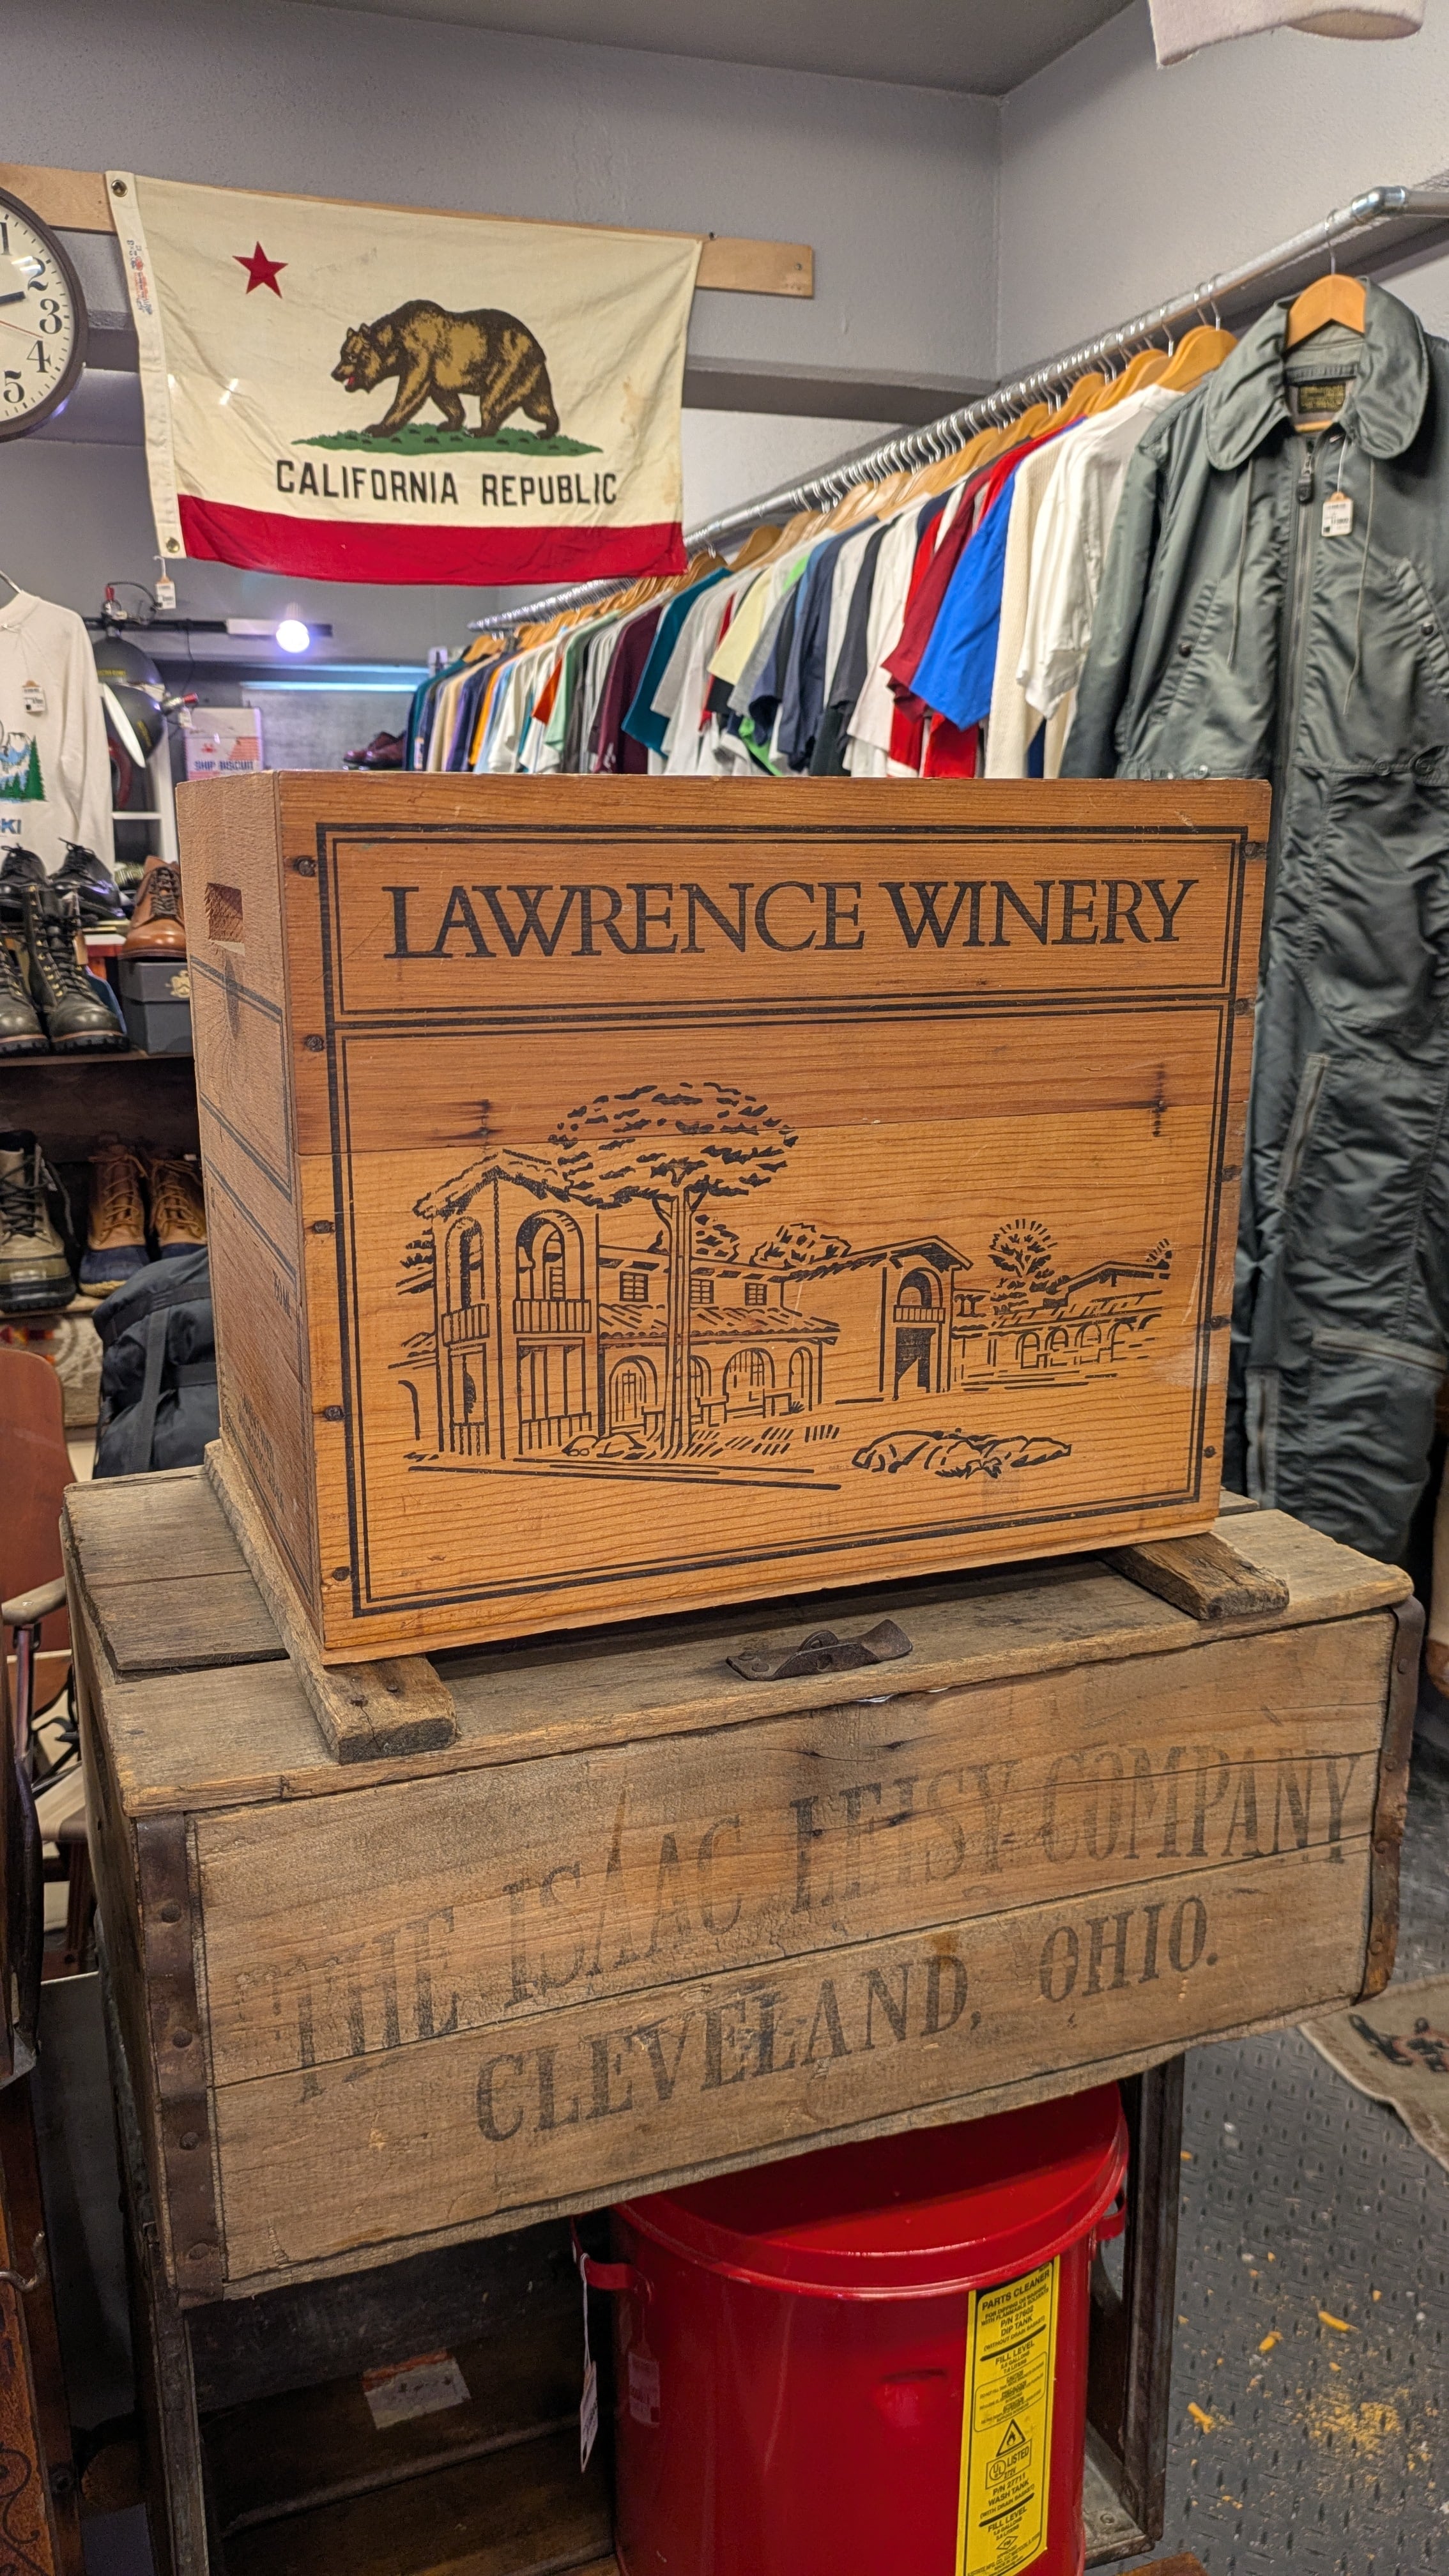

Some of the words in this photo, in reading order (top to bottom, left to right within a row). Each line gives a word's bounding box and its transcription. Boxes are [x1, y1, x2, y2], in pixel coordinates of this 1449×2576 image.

[27, 257, 49, 291] 2
[39, 298, 63, 334] 3
[26, 340, 52, 373] 4
[3, 370, 25, 404] 5
[276, 459, 458, 505] CALIFORNIA
[482, 473, 617, 507] REPUBLIC
[0, 818, 22, 835] KI
[383, 881, 866, 959] LAWRENCE
[880, 878, 1193, 949] WINERY
[502, 1813, 742, 2009] ISAAC
[1041, 1744, 1362, 1864] COMPANY
[475, 1951, 981, 2142] CLEVELAND,
[1039, 1894, 1218, 2004] OHIO.
[982, 2292, 1011, 2310] PARTS
[1013, 2269, 1050, 2297] CLEANER
[981, 2317, 995, 2326] WITH
[996, 2304, 1027, 2320] FLAMMABLE
[1000, 2316, 1013, 2327] P/N
[1000, 2326, 1014, 2336] DIP
[1015, 2314, 1033, 2329] TANK
[984, 2337, 1009, 2352] (WITHOUT
[995, 2353, 1011, 2365] FILL
[1013, 2340, 1035, 2357] LEVEL
[1007, 2445, 1029, 2467] LISTED
[988, 2492, 1010, 2506] WASH
[1012, 2478, 1029, 2495] TANK
[993, 2484, 1006, 2496] P/N
[1007, 2472, 1025, 2489] 27711
[988, 2520, 1003, 2533] FILL
[1006, 2506, 1027, 2524] LEVEL
